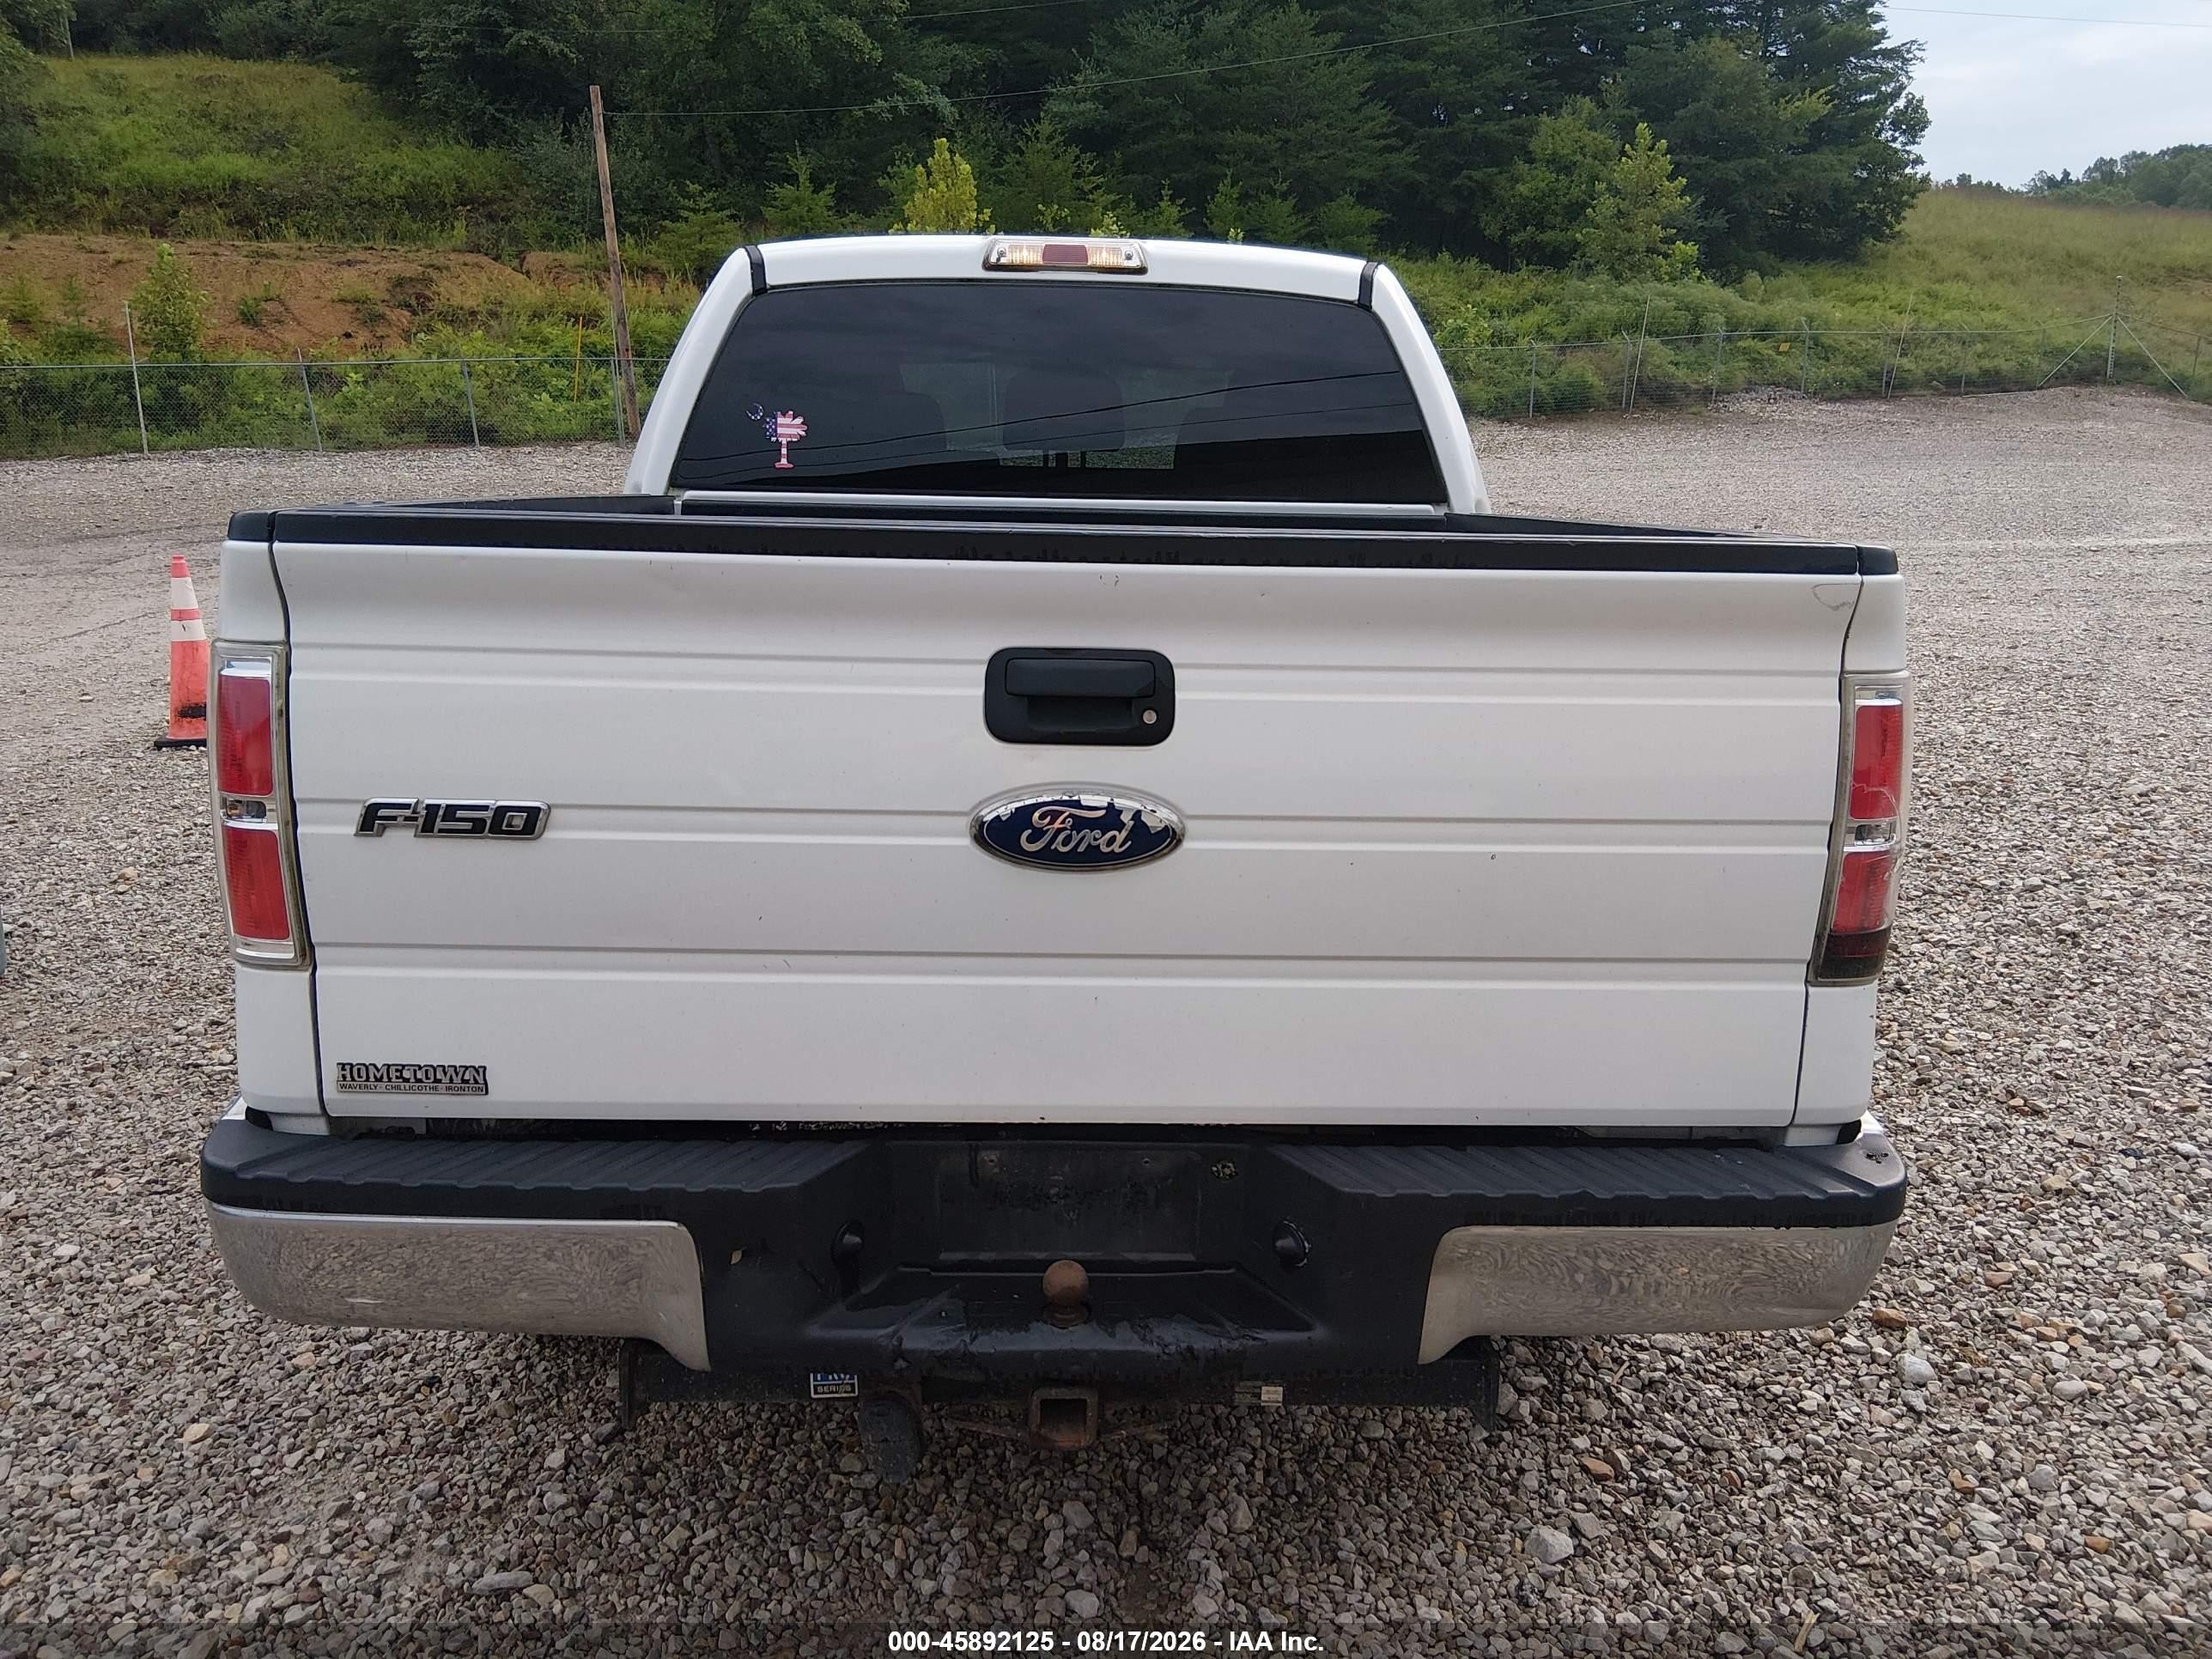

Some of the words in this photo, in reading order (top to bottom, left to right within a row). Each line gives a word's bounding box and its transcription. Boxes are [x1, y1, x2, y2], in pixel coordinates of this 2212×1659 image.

[353, 797, 551, 840] F-150
[1019, 805, 1134, 854] Ford
[336, 1062, 487, 1084] HOMETOWN
[385, 1084, 440, 1092] CHILLICOTHE
